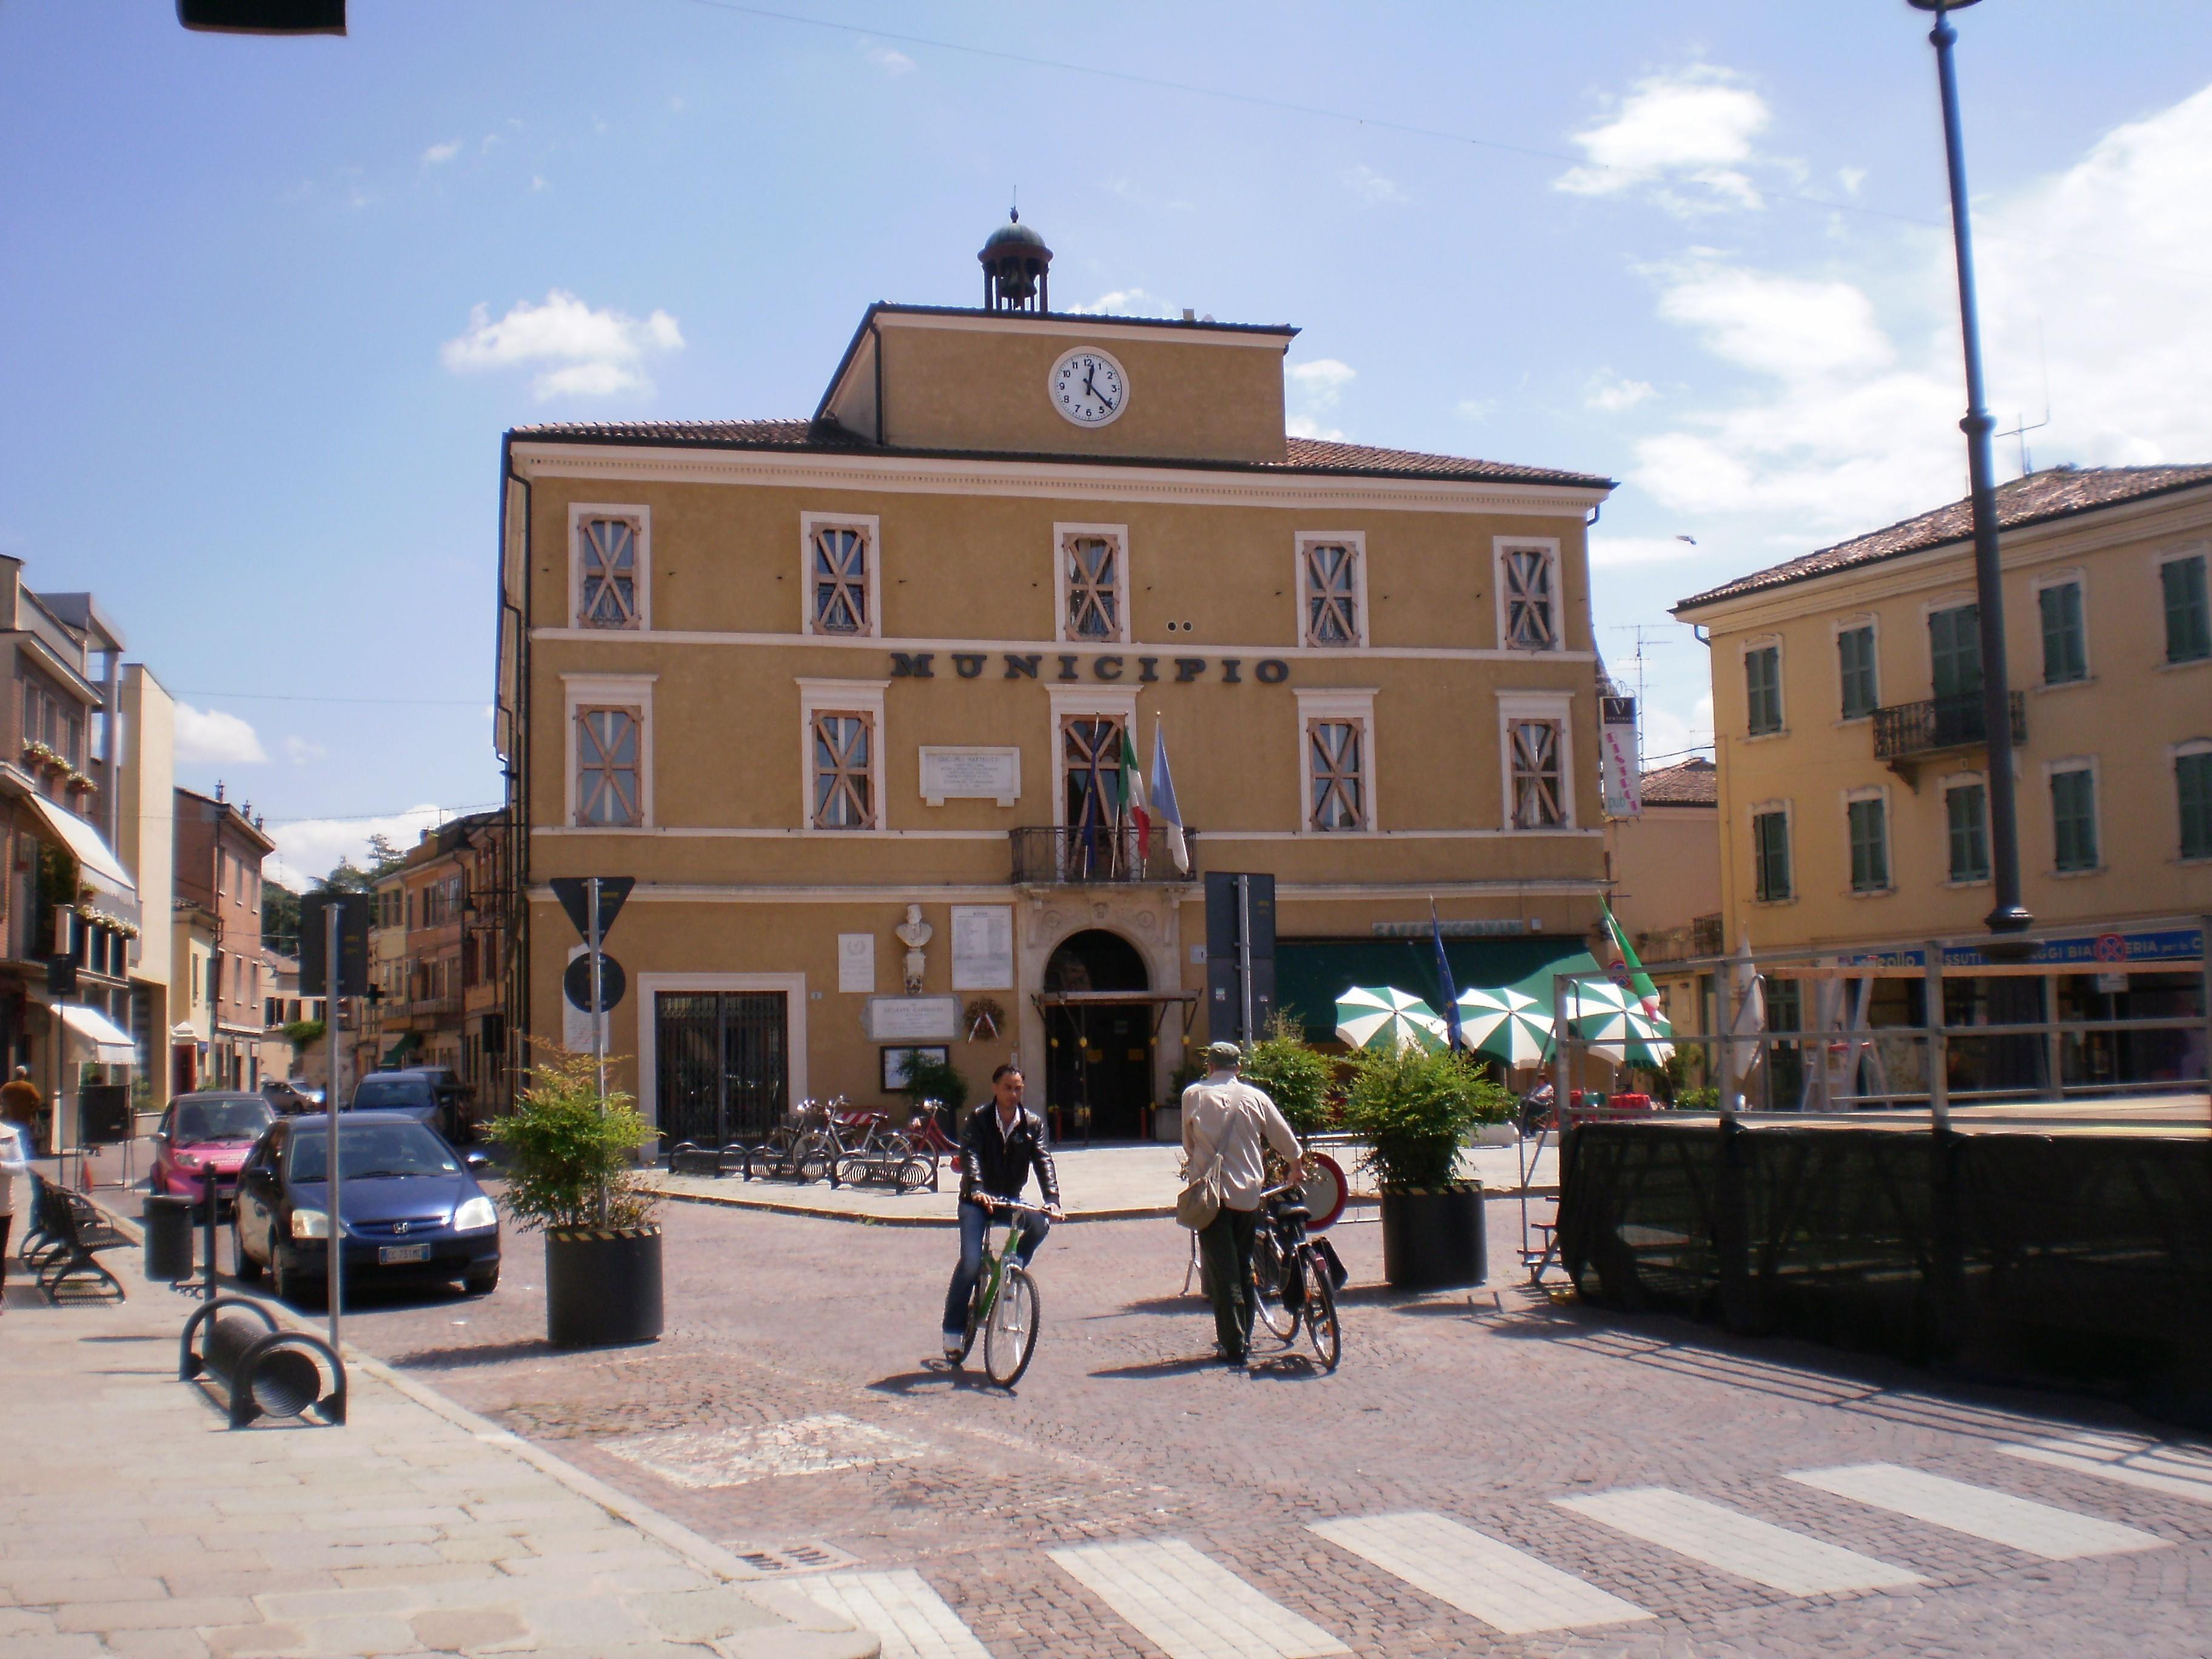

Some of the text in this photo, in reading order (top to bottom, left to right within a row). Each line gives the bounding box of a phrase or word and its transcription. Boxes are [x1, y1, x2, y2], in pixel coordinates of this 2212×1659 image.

[890, 652, 1290, 683] MUNICIPIO
[1607, 791, 1626, 813] pub
[2068, 940, 2159, 958] BIAERIA
